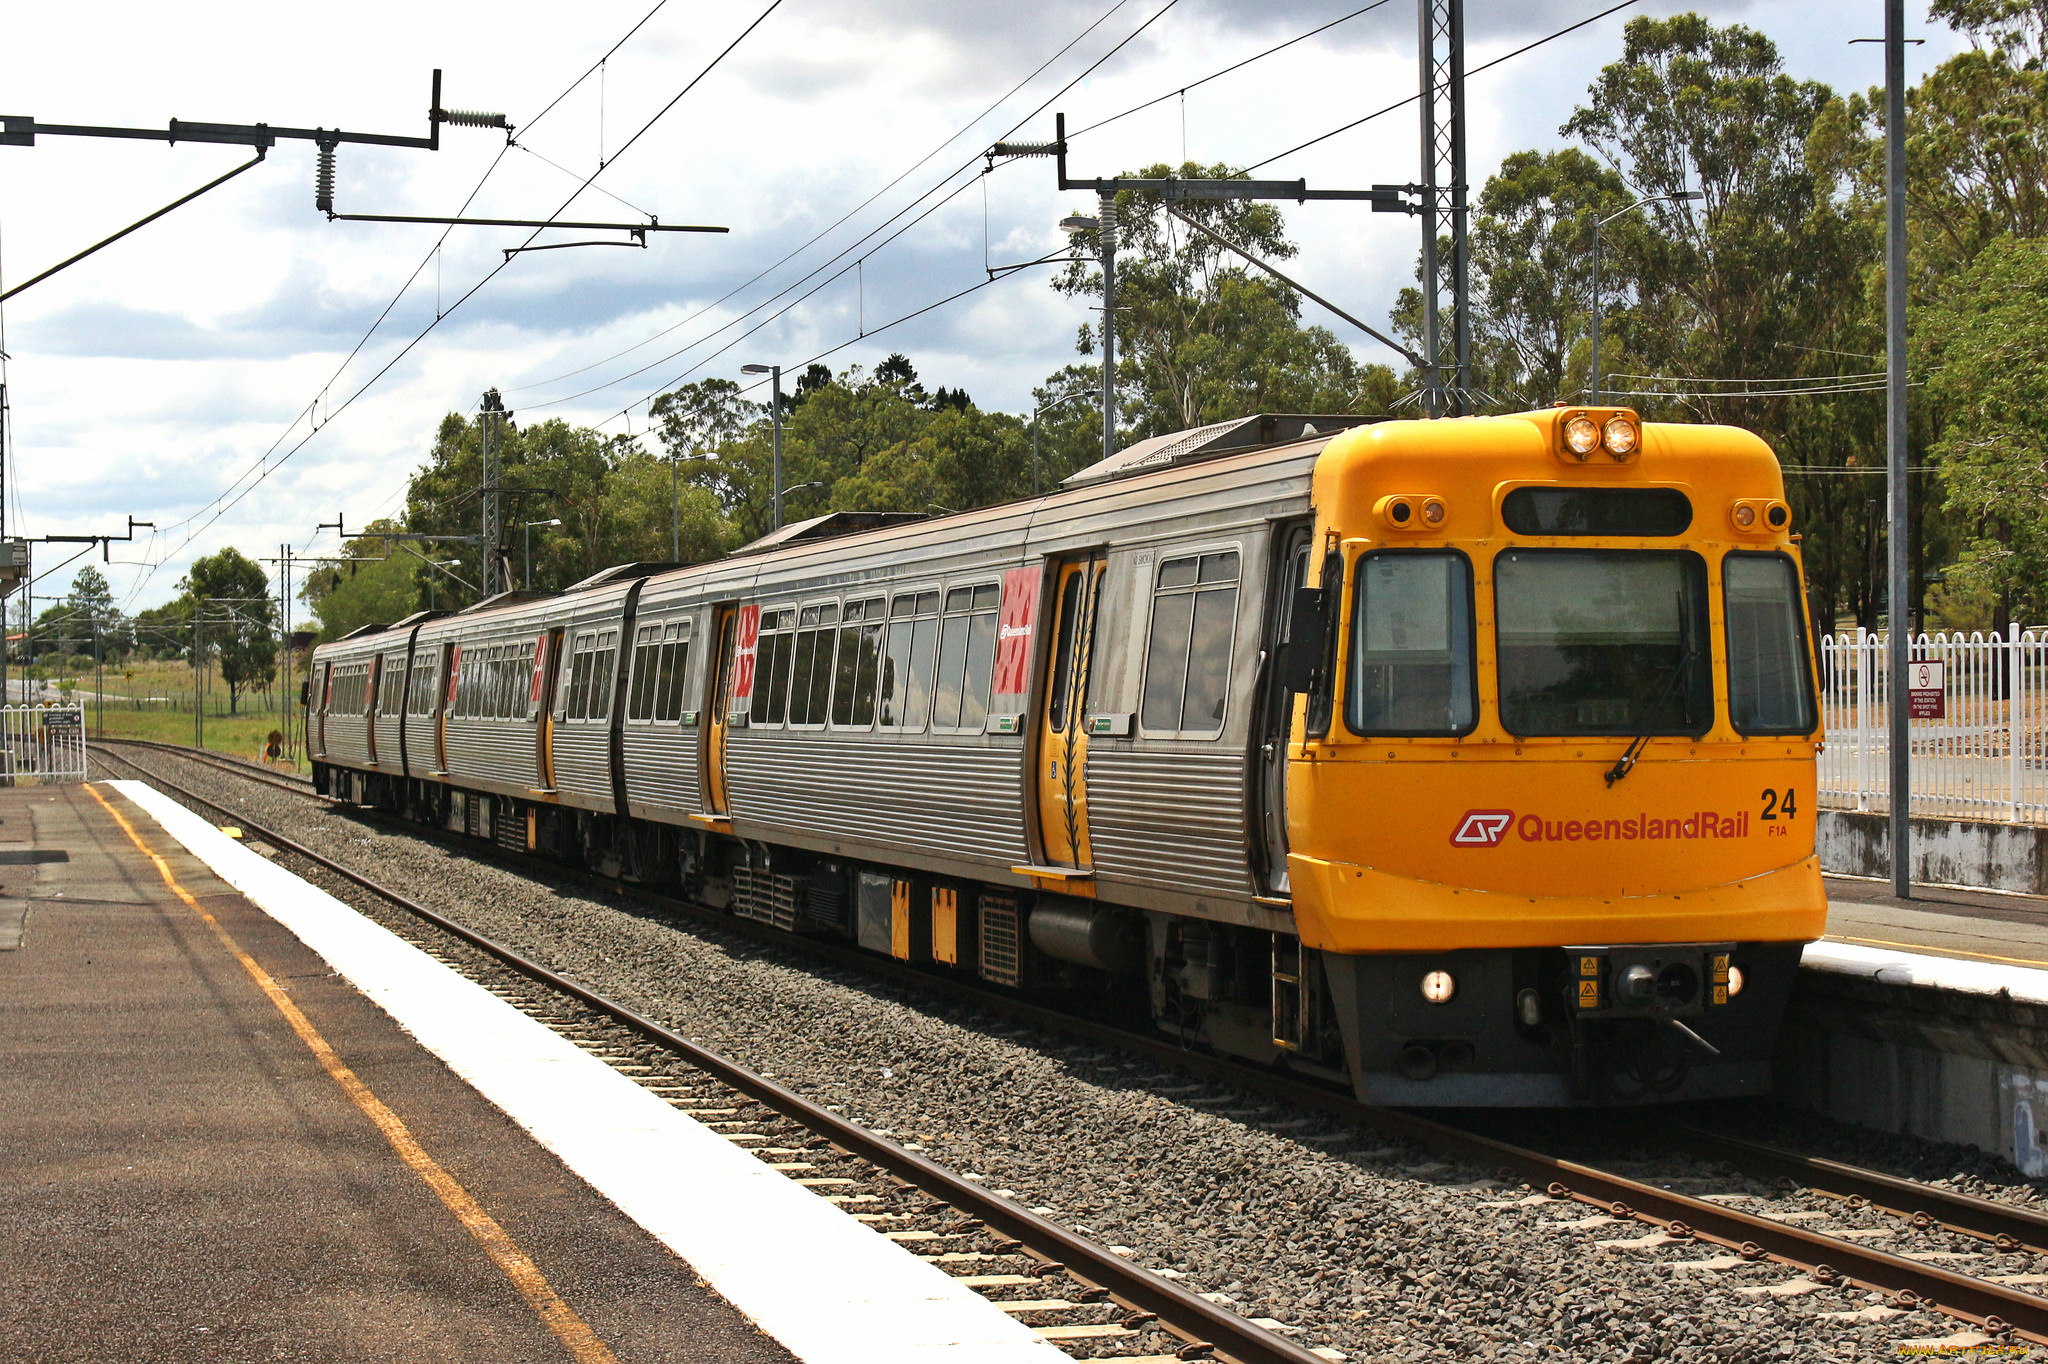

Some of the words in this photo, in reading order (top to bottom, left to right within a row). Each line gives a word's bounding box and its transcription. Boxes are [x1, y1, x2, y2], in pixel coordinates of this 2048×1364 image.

[1760, 788, 1797, 820] 24
[1518, 812, 1749, 842] QueenslandRail
[1769, 825, 1787, 837] F1A
